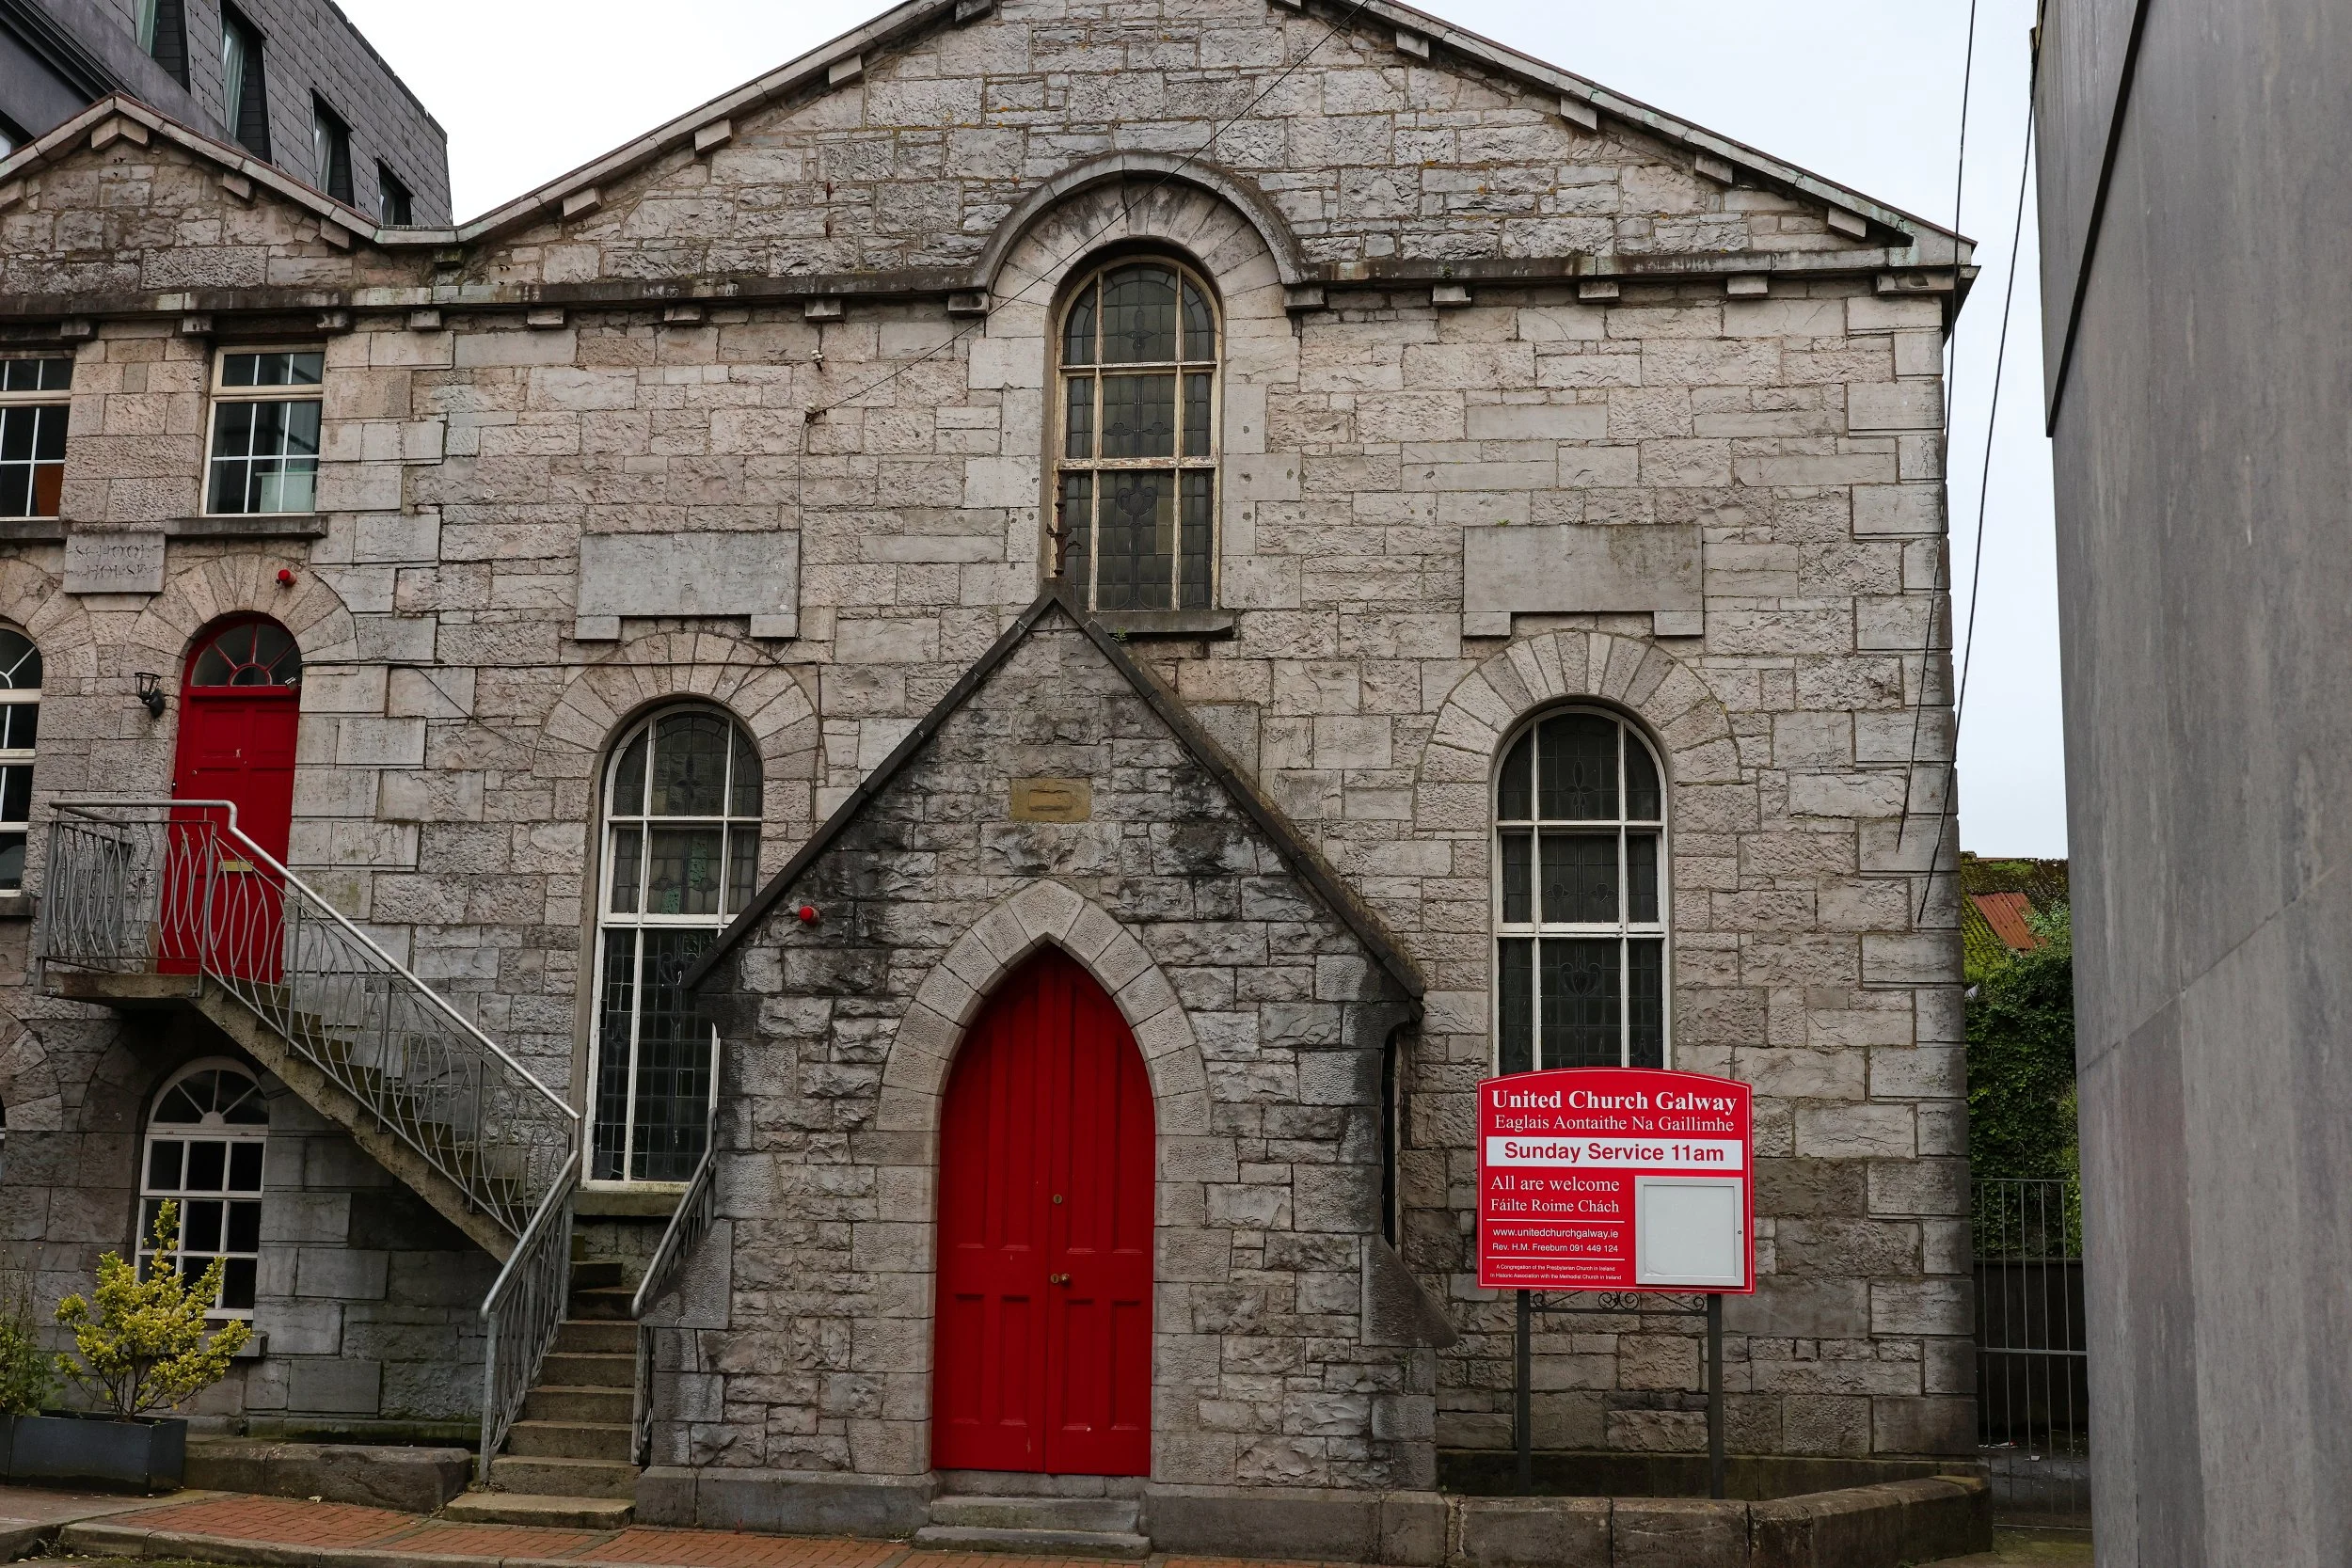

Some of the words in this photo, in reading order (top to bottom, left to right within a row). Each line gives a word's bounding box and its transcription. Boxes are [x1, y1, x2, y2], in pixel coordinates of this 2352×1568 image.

[1492, 1090, 1562, 1109] United
[1568, 1090, 1648, 1110] Church
[1656, 1091, 1737, 1116] Galway
[1495, 1114, 1549, 1132] Eaglais
[1553, 1115, 1628, 1130] Aontaithe
[1631, 1116, 1654, 1131] Na
[1659, 1116, 1734, 1132] Gaillimhe
[1504, 1141, 1581, 1164] Sunday
[1588, 1142, 1664, 1161] Service
[1672, 1144, 1724, 1162] 11am
[1490, 1175, 1515, 1190] All
[1520, 1180, 1544, 1191] are
[1549, 1177, 1620, 1192] welcome
[1490, 1198, 1528, 1212] Fáilte
[1532, 1199, 1574, 1212] Roime
[1578, 1199, 1619, 1213] Chách
[1492, 1227, 1619, 1240] www.unitedchurchgalway.ie
[1492, 1243, 1509, 1251] Rev.
[1511, 1243, 1531, 1251] H.M.
[1569, 1243, 1584, 1252] 091
[1586, 1243, 1602, 1253] 449
[1603, 1244, 1619, 1253] 124
